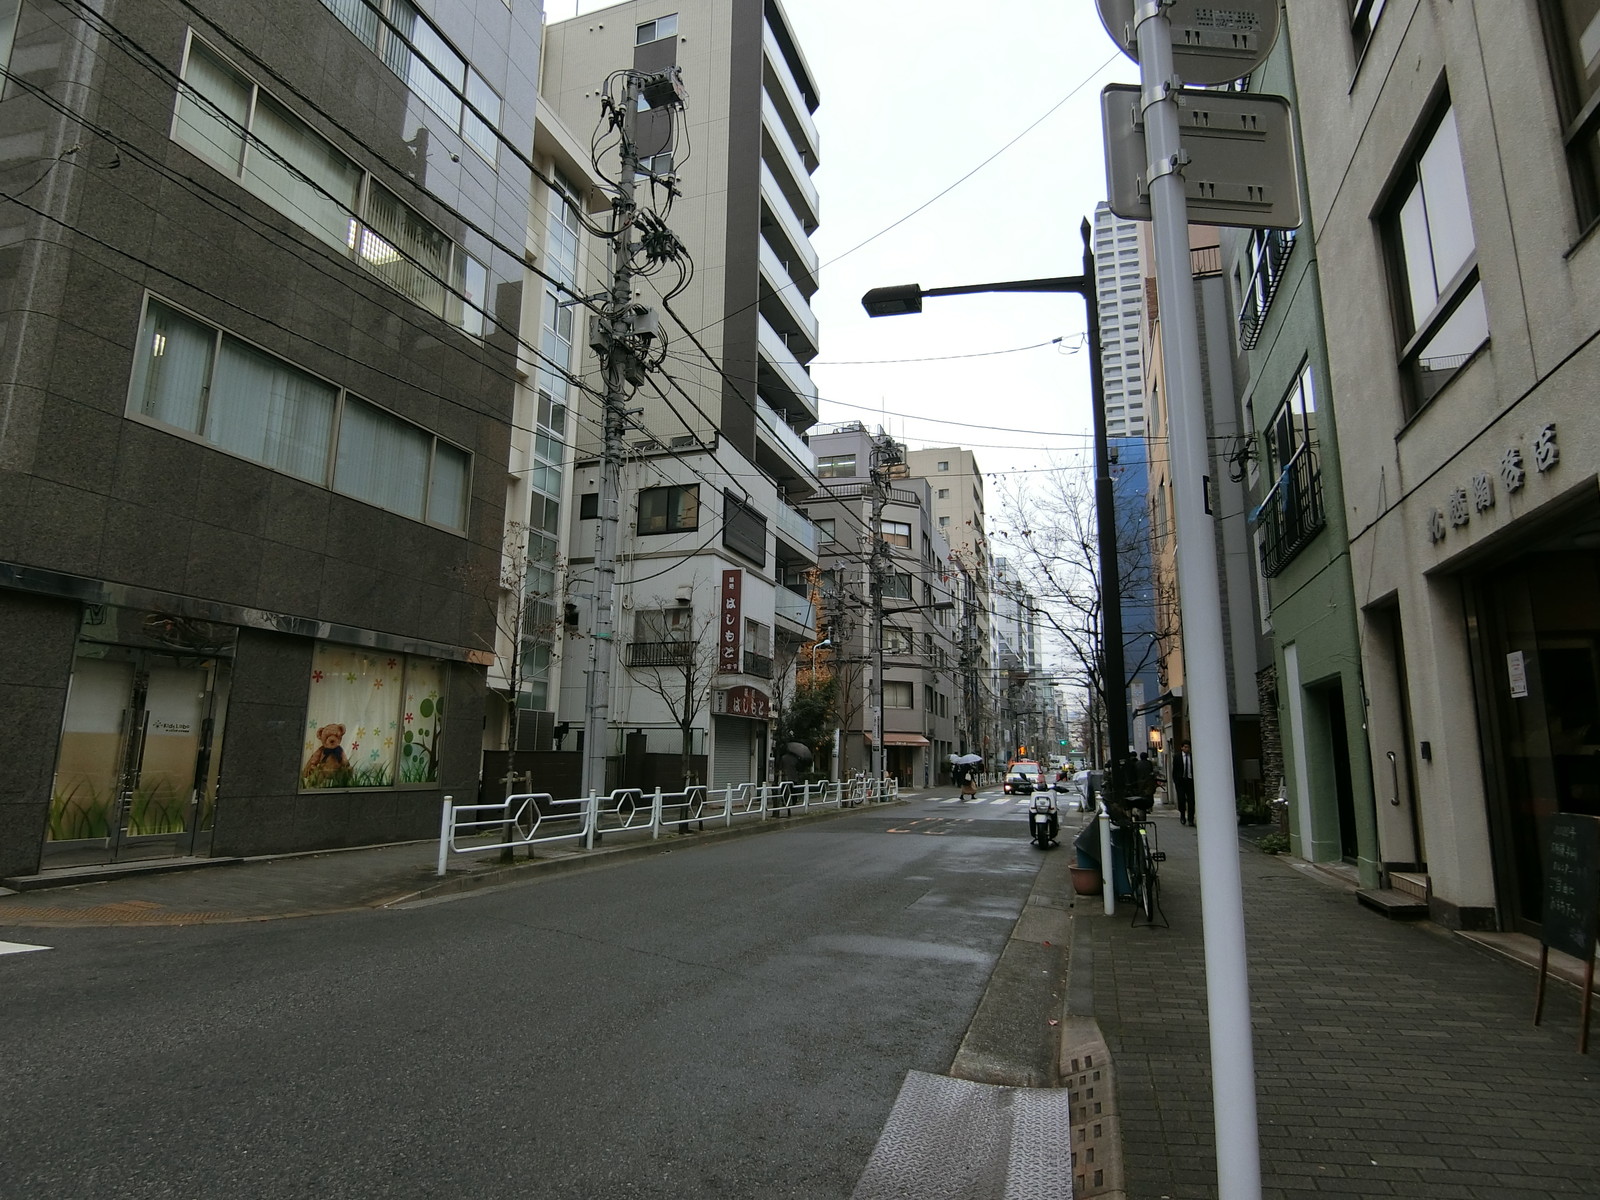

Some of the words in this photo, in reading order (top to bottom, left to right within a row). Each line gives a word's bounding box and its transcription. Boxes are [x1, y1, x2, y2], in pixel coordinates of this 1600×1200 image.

[724, 598, 736, 659] はしもと
[733, 696, 765, 716] はしもと
